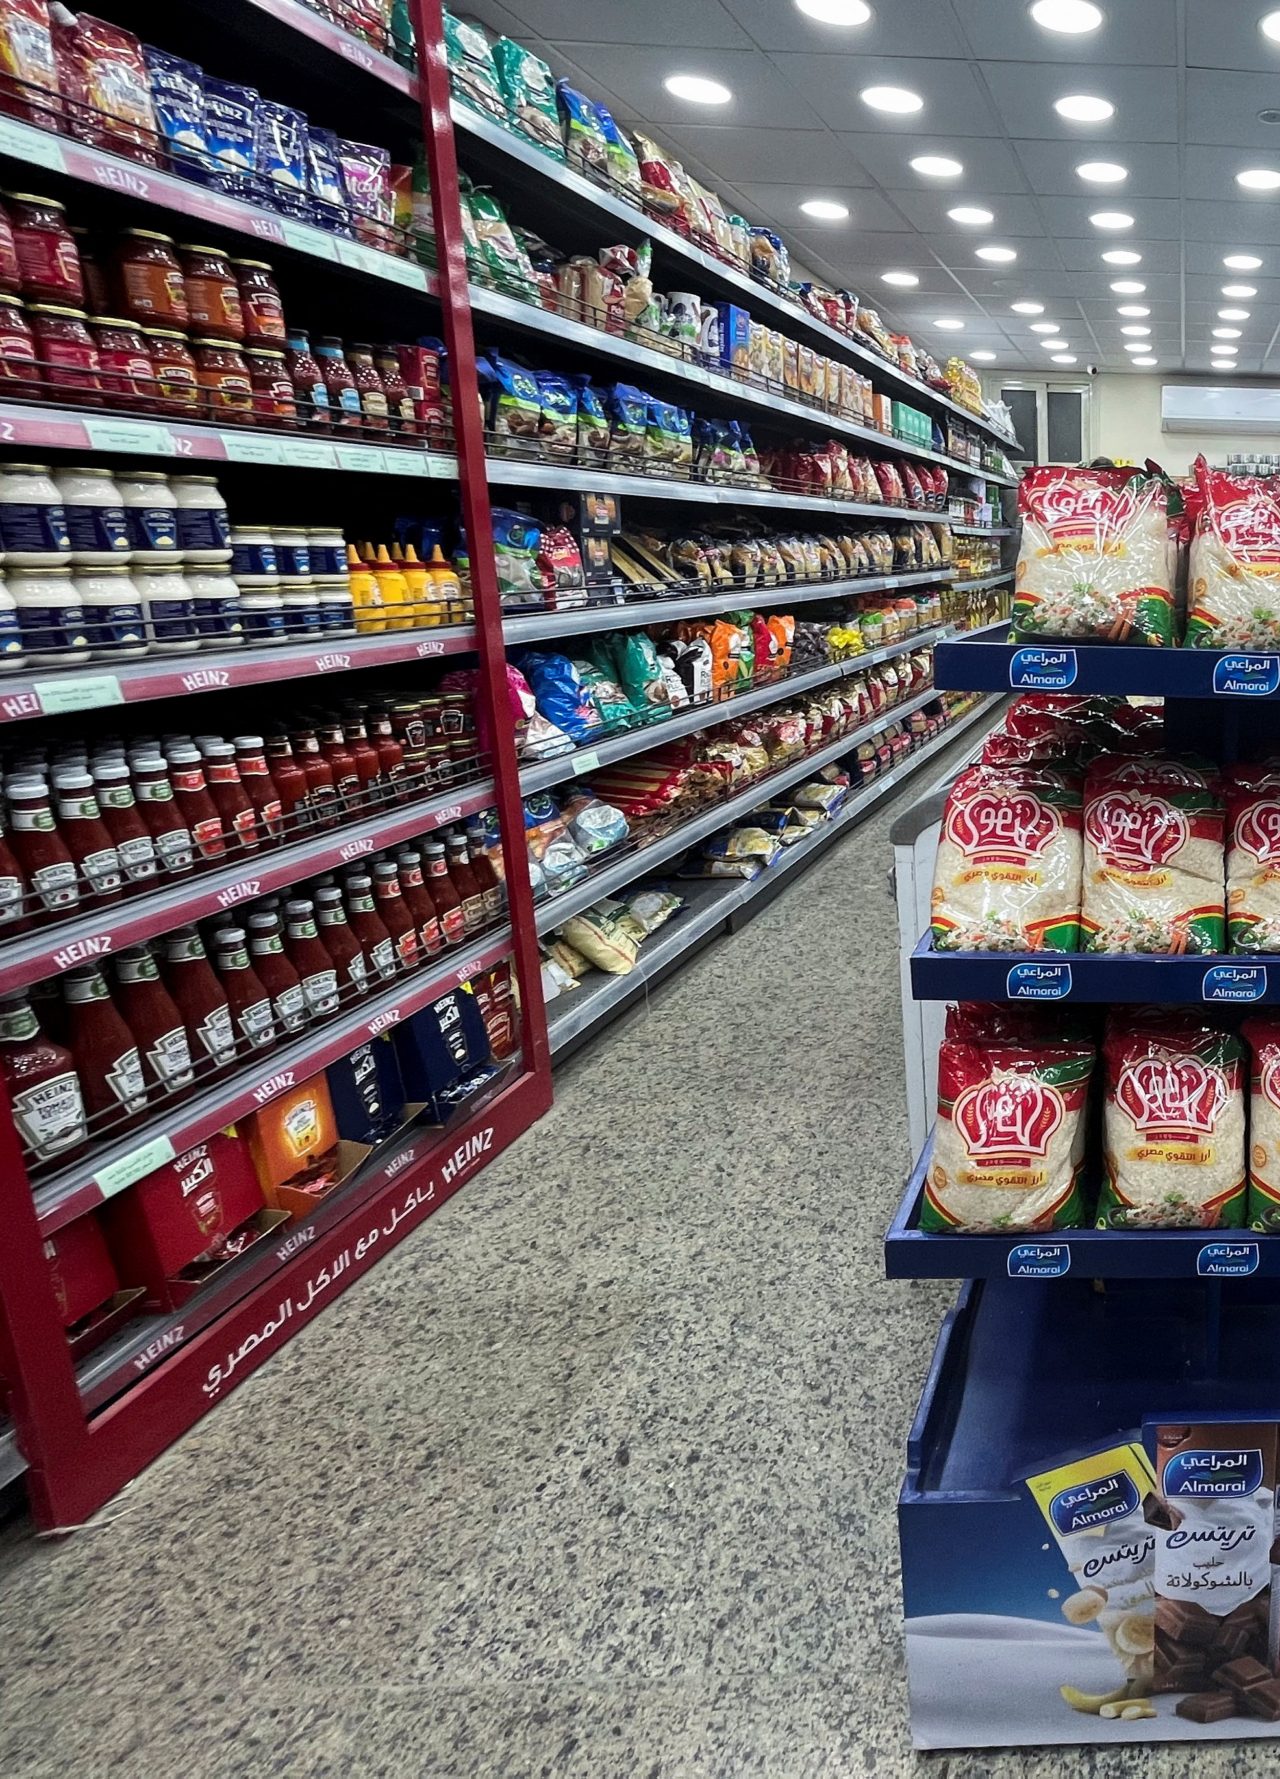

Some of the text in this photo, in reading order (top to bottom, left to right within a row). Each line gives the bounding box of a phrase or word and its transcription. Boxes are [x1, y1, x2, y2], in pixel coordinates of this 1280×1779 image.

[339, 40, 374, 69] HEINZ
[94, 166, 150, 198] HEINZ
[251, 219, 282, 242] HEIN
[416, 640, 445, 657] HEINZ
[1021, 652, 1067, 665] المراعي
[315, 654, 352, 673] HEINZ
[1224, 659, 1271, 673] المراعي
[183, 671, 230, 692] HEINZ
[1020, 673, 1067, 687] Almarai
[1223, 679, 1270, 692] Almarai
[3, 692, 41, 719] HEI
[434, 805, 462, 825] HEINZ
[339, 839, 374, 861] HEINZ
[217, 881, 261, 907] HEINZ
[53, 936, 112, 970] HEINZ
[456, 960, 482, 982] HEINZ
[1017, 965, 1063, 981] المراعي
[1213, 967, 1258, 983] المراعي
[1017, 985, 1064, 998] Almarai
[1212, 986, 1258, 999] Almarai
[367, 1009, 401, 1035] HEINZ
[32, 1081, 74, 1105] HEINZ
[253, 1071, 296, 1103] HEINZ
[173, 1143, 209, 1173] HEINZ
[384, 1148, 415, 1178] HEINZ
[276, 1225, 316, 1261] HEINZ
[1016, 1246, 1060, 1260] المراعي
[1208, 1245, 1251, 1260] المراعي
[202, 1127, 495, 1399] HEINZ ياكل مع الاكل المصري
[1016, 1263, 1061, 1275] Almarai
[1206, 1262, 1250, 1274] Almarai
[133, 1325, 185, 1371] HEINZ
[1180, 1454, 1248, 1471] المراعي
[1060, 1479, 1119, 1509] المراعي
[1179, 1480, 1246, 1493] Almarai
[1072, 1501, 1129, 1529] Almarai
[1166, 1525, 1256, 1551] تريتس
[1193, 1557, 1225, 1569] حليب
[1166, 1571, 1254, 1590] بالشوكولاتة
